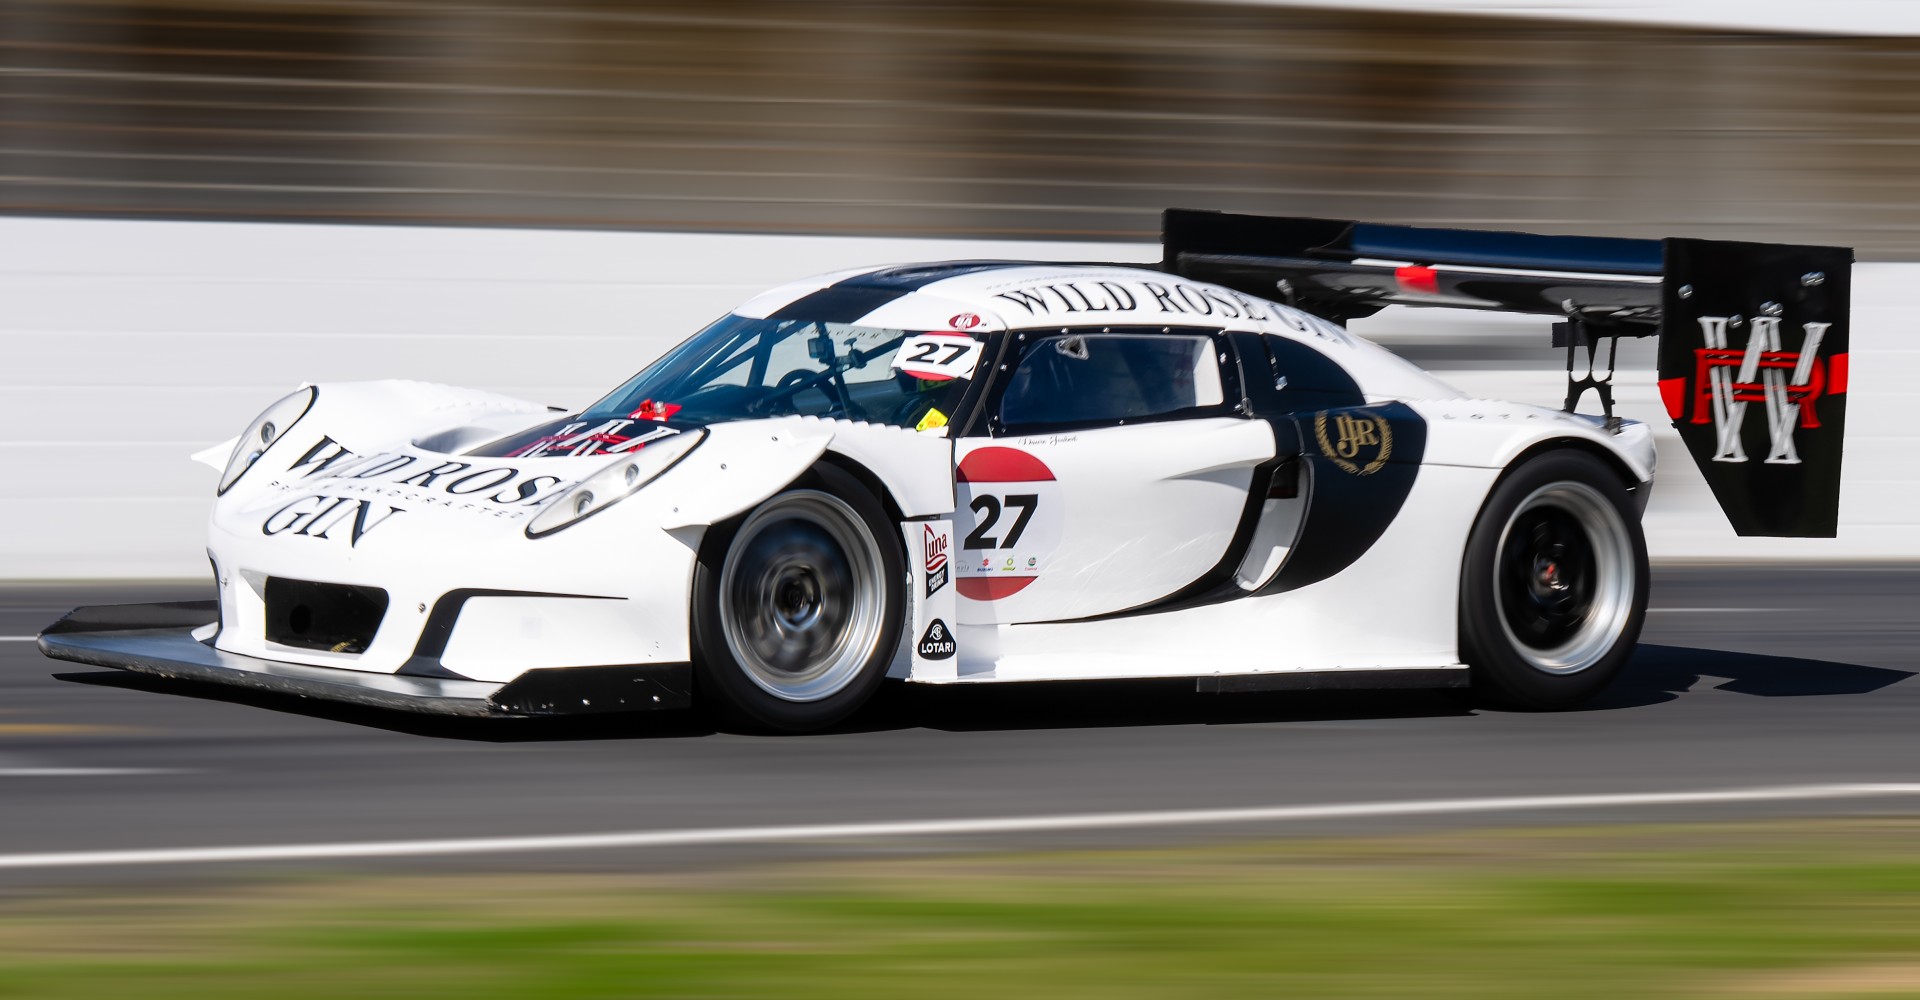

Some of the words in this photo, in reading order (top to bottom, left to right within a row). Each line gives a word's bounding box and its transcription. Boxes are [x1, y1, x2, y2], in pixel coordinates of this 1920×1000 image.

[992, 282, 1137, 316] WILD
[1136, 281, 1268, 321] ROSE
[905, 341, 972, 366] 27
[262, 495, 407, 549] GIN
[963, 493, 1039, 550] 27
[924, 523, 948, 571] Luna
[921, 642, 954, 654] LOTARI
